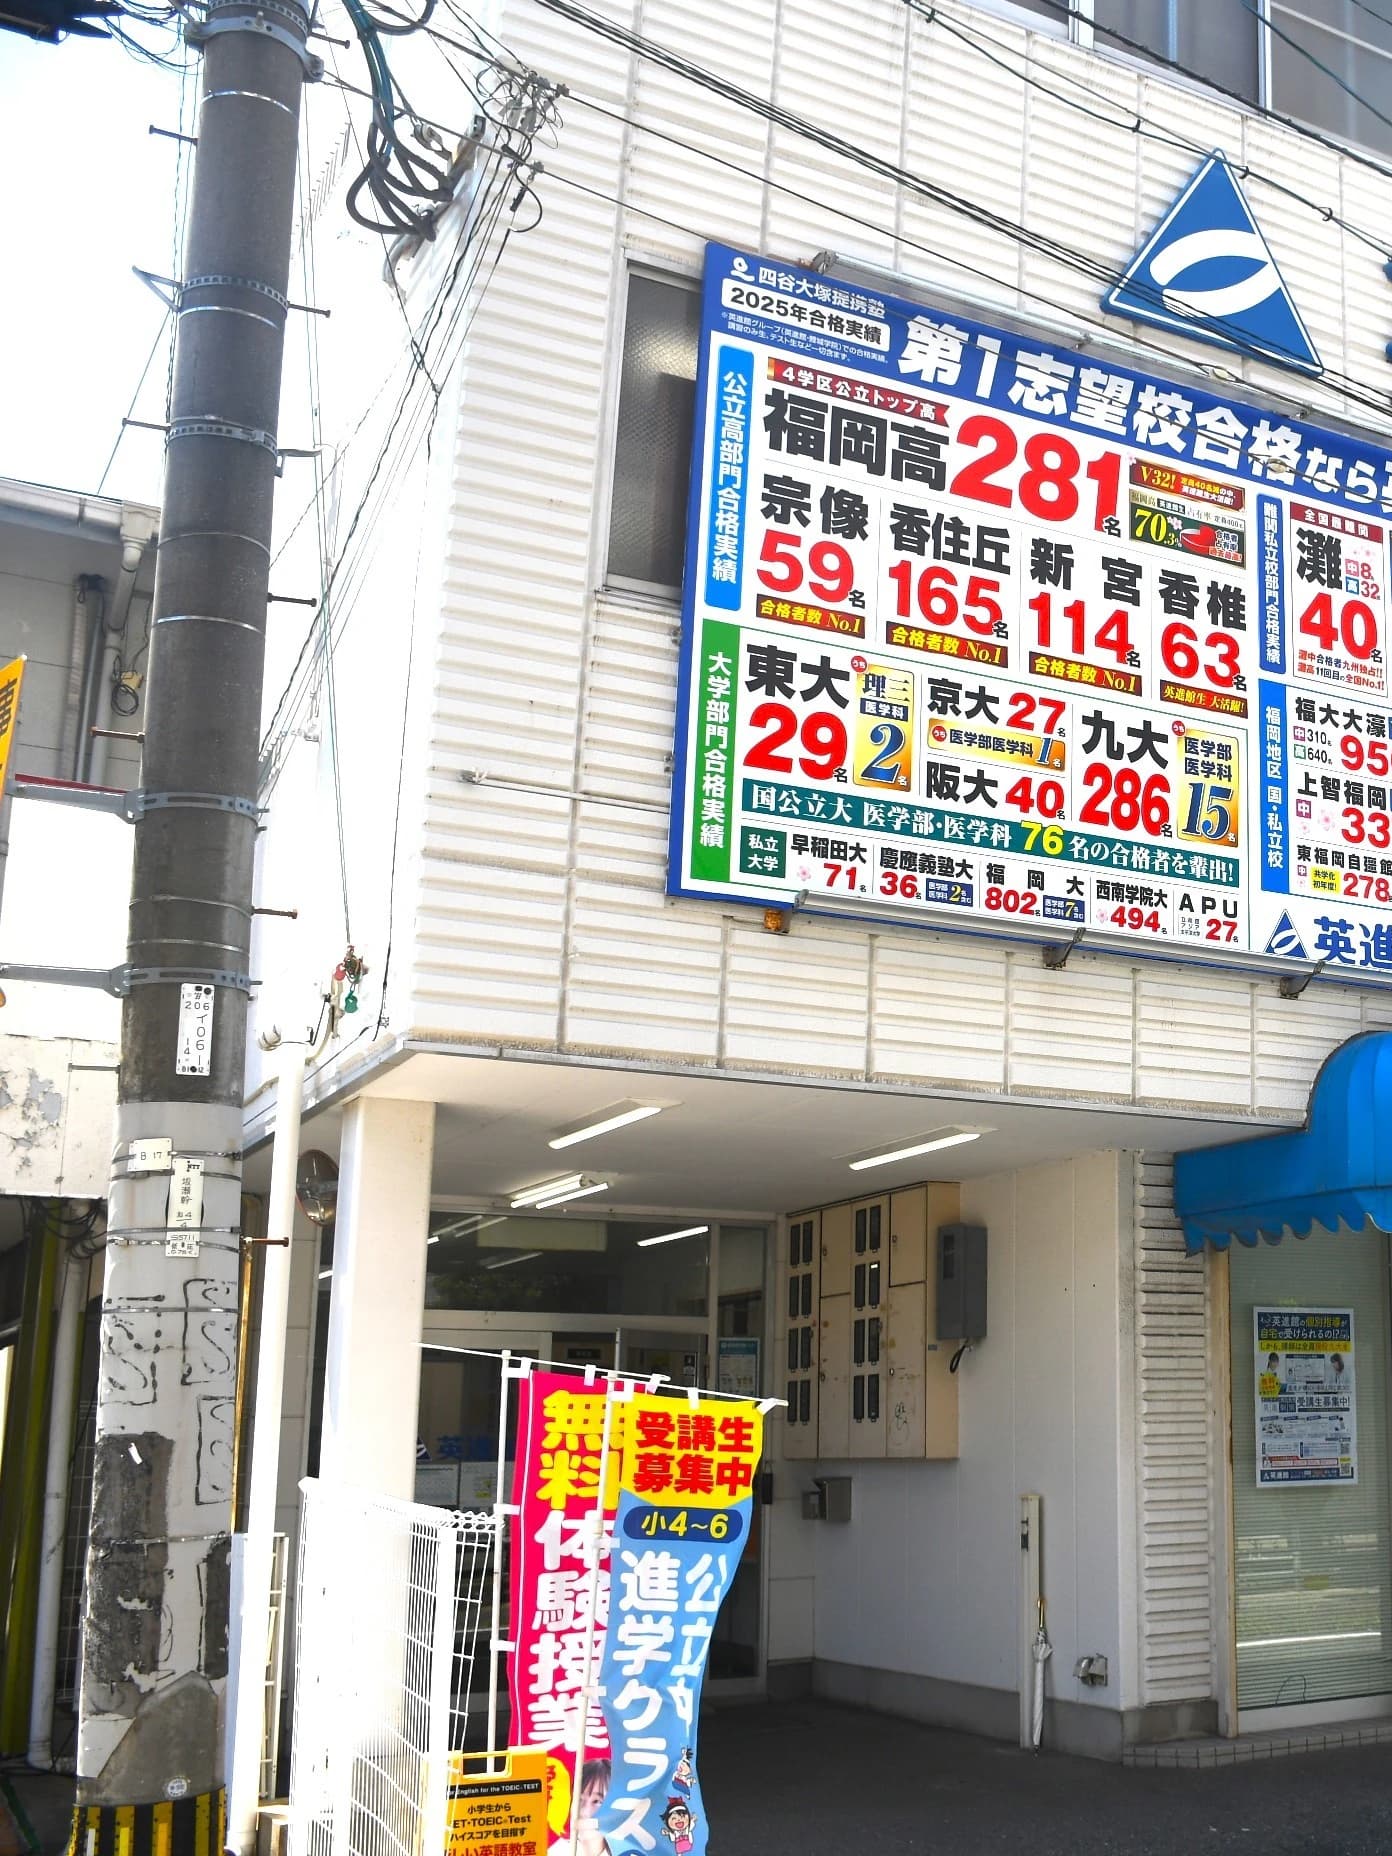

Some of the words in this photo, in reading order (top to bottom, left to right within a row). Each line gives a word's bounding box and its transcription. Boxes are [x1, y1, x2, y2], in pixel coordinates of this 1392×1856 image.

[758, 267, 886, 319] 四谷大塚提携塾
[730, 286, 882, 346] 2025年合格実績
[783, 367, 937, 422] 4学区公立トップ高
[711, 370, 749, 584] 公立高部門合格実績
[762, 387, 950, 492] 福岡高
[950, 414, 1121, 538] 281名
[1141, 465, 1176, 490] V32!
[760, 474, 869, 541] 宗像
[890, 503, 1011, 575] 香住丘
[1296, 528, 1342, 590] 灘
[757, 529, 866, 609] 59名
[1030, 537, 1142, 607] 新宮
[1263, 502, 1282, 665] 難関私立校部門合格実績
[760, 599, 821, 626] 合格者数
[826, 610, 861, 634] No.1
[889, 559, 1009, 640] 165名
[1158, 568, 1247, 632] 香椎
[892, 627, 958, 655] 合格者数
[964, 641, 1001, 665] No.1
[1029, 591, 1141, 669] 114名
[1300, 592, 1382, 663] 40名
[745, 644, 850, 710] 東大
[853, 658, 866, 670] うち
[1034, 655, 1097, 685] 合格者数
[1101, 671, 1137, 694] No.1
[1160, 622, 1247, 692] 63名
[862, 673, 911, 705] 理三
[864, 699, 906, 721] 医学科
[927, 677, 1000, 725] 京大
[1007, 693, 1067, 738] 27名
[1163, 685, 1206, 707] 英進館生
[1210, 695, 1246, 714] 大活躍!
[1173, 723, 1186, 733] うち
[1295, 696, 1386, 738] 福大大濠
[700, 651, 733, 849] 大学部門合格実績
[743, 702, 848, 784] 29名
[932, 730, 948, 740] うち
[949, 730, 1033, 758] 医学部医学科
[1081, 710, 1170, 770] 九大
[1184, 738, 1232, 762] 医学部
[1265, 706, 1282, 780] 福岡地区
[927, 762, 999, 809] 阪大
[1005, 777, 1065, 821] 40名
[1184, 758, 1232, 782] 医学科
[1297, 772, 1387, 811] 上智福岡
[1079, 762, 1173, 838] 286名
[749, 834, 779, 853] 私立
[752, 784, 853, 824] 国公立大
[863, 800, 1013, 851] 医学部・医学科
[1020, 820, 1065, 855] 76
[1068, 834, 1235, 884] 名の合格者を輩出!
[1267, 786, 1284, 868] 国・私立校
[748, 854, 778, 872] 大学
[791, 834, 868, 864] 早稲田大
[880, 847, 974, 880] 慶應義塾大
[986, 863, 1085, 897] 福岡大
[1096, 879, 1168, 909] 西南学院大
[1313, 880, 1337, 891] 初年度!
[1314, 870, 1336, 881] 共学化
[1179, 893, 1238, 918] APU
[140, 1151, 147, 1161] B
[635, 1411, 755, 1455] 受講生
[633, 1452, 753, 1497] 募集中
[468, 1803, 512, 1815] 小学生から
[480, 1786, 489, 1794] for
[450, 1827, 527, 1842] ハイスコアを目指す
[508, 1814, 531, 1825] Test
